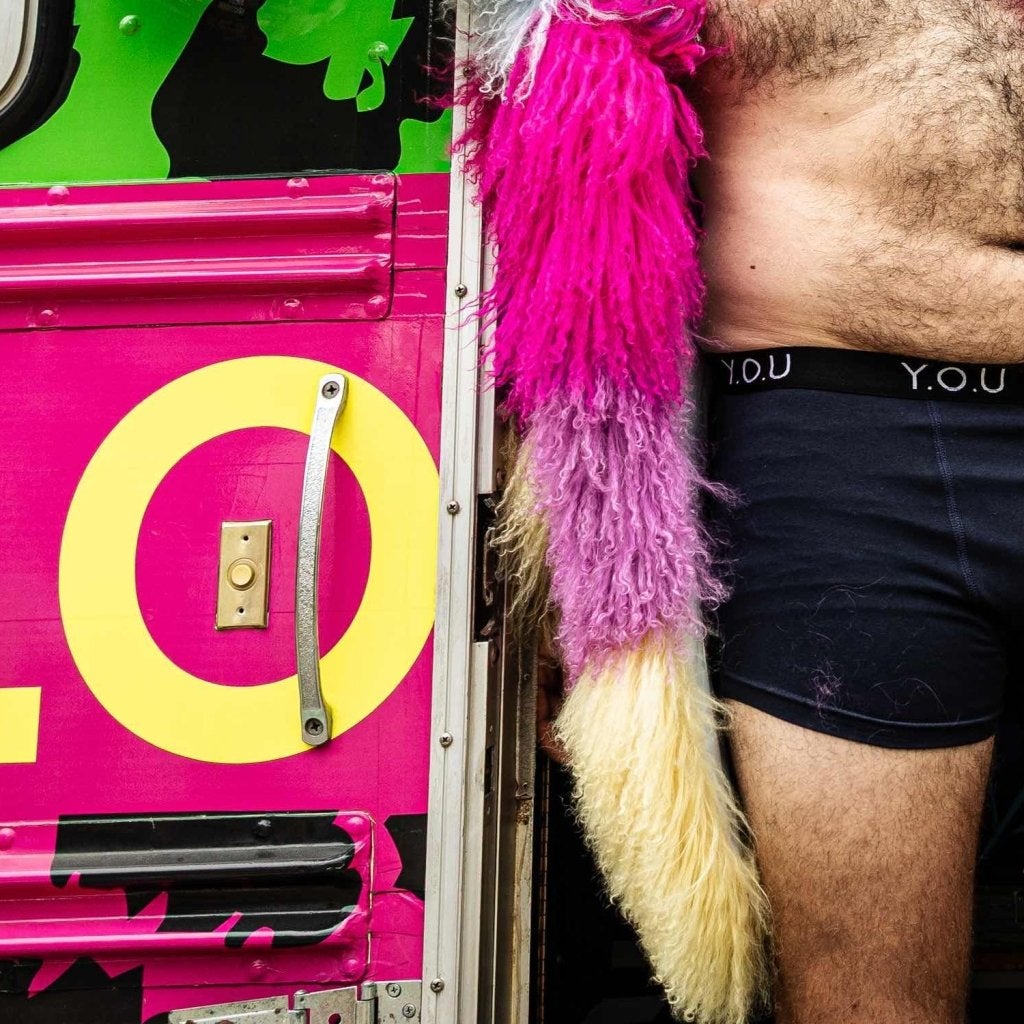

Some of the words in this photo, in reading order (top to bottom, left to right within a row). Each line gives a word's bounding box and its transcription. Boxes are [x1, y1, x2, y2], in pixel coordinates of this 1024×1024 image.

[721, 353, 792, 385] Y.O.U
[901, 362, 1005, 394] Y.O.U
[0, 355, 440, 764] O
